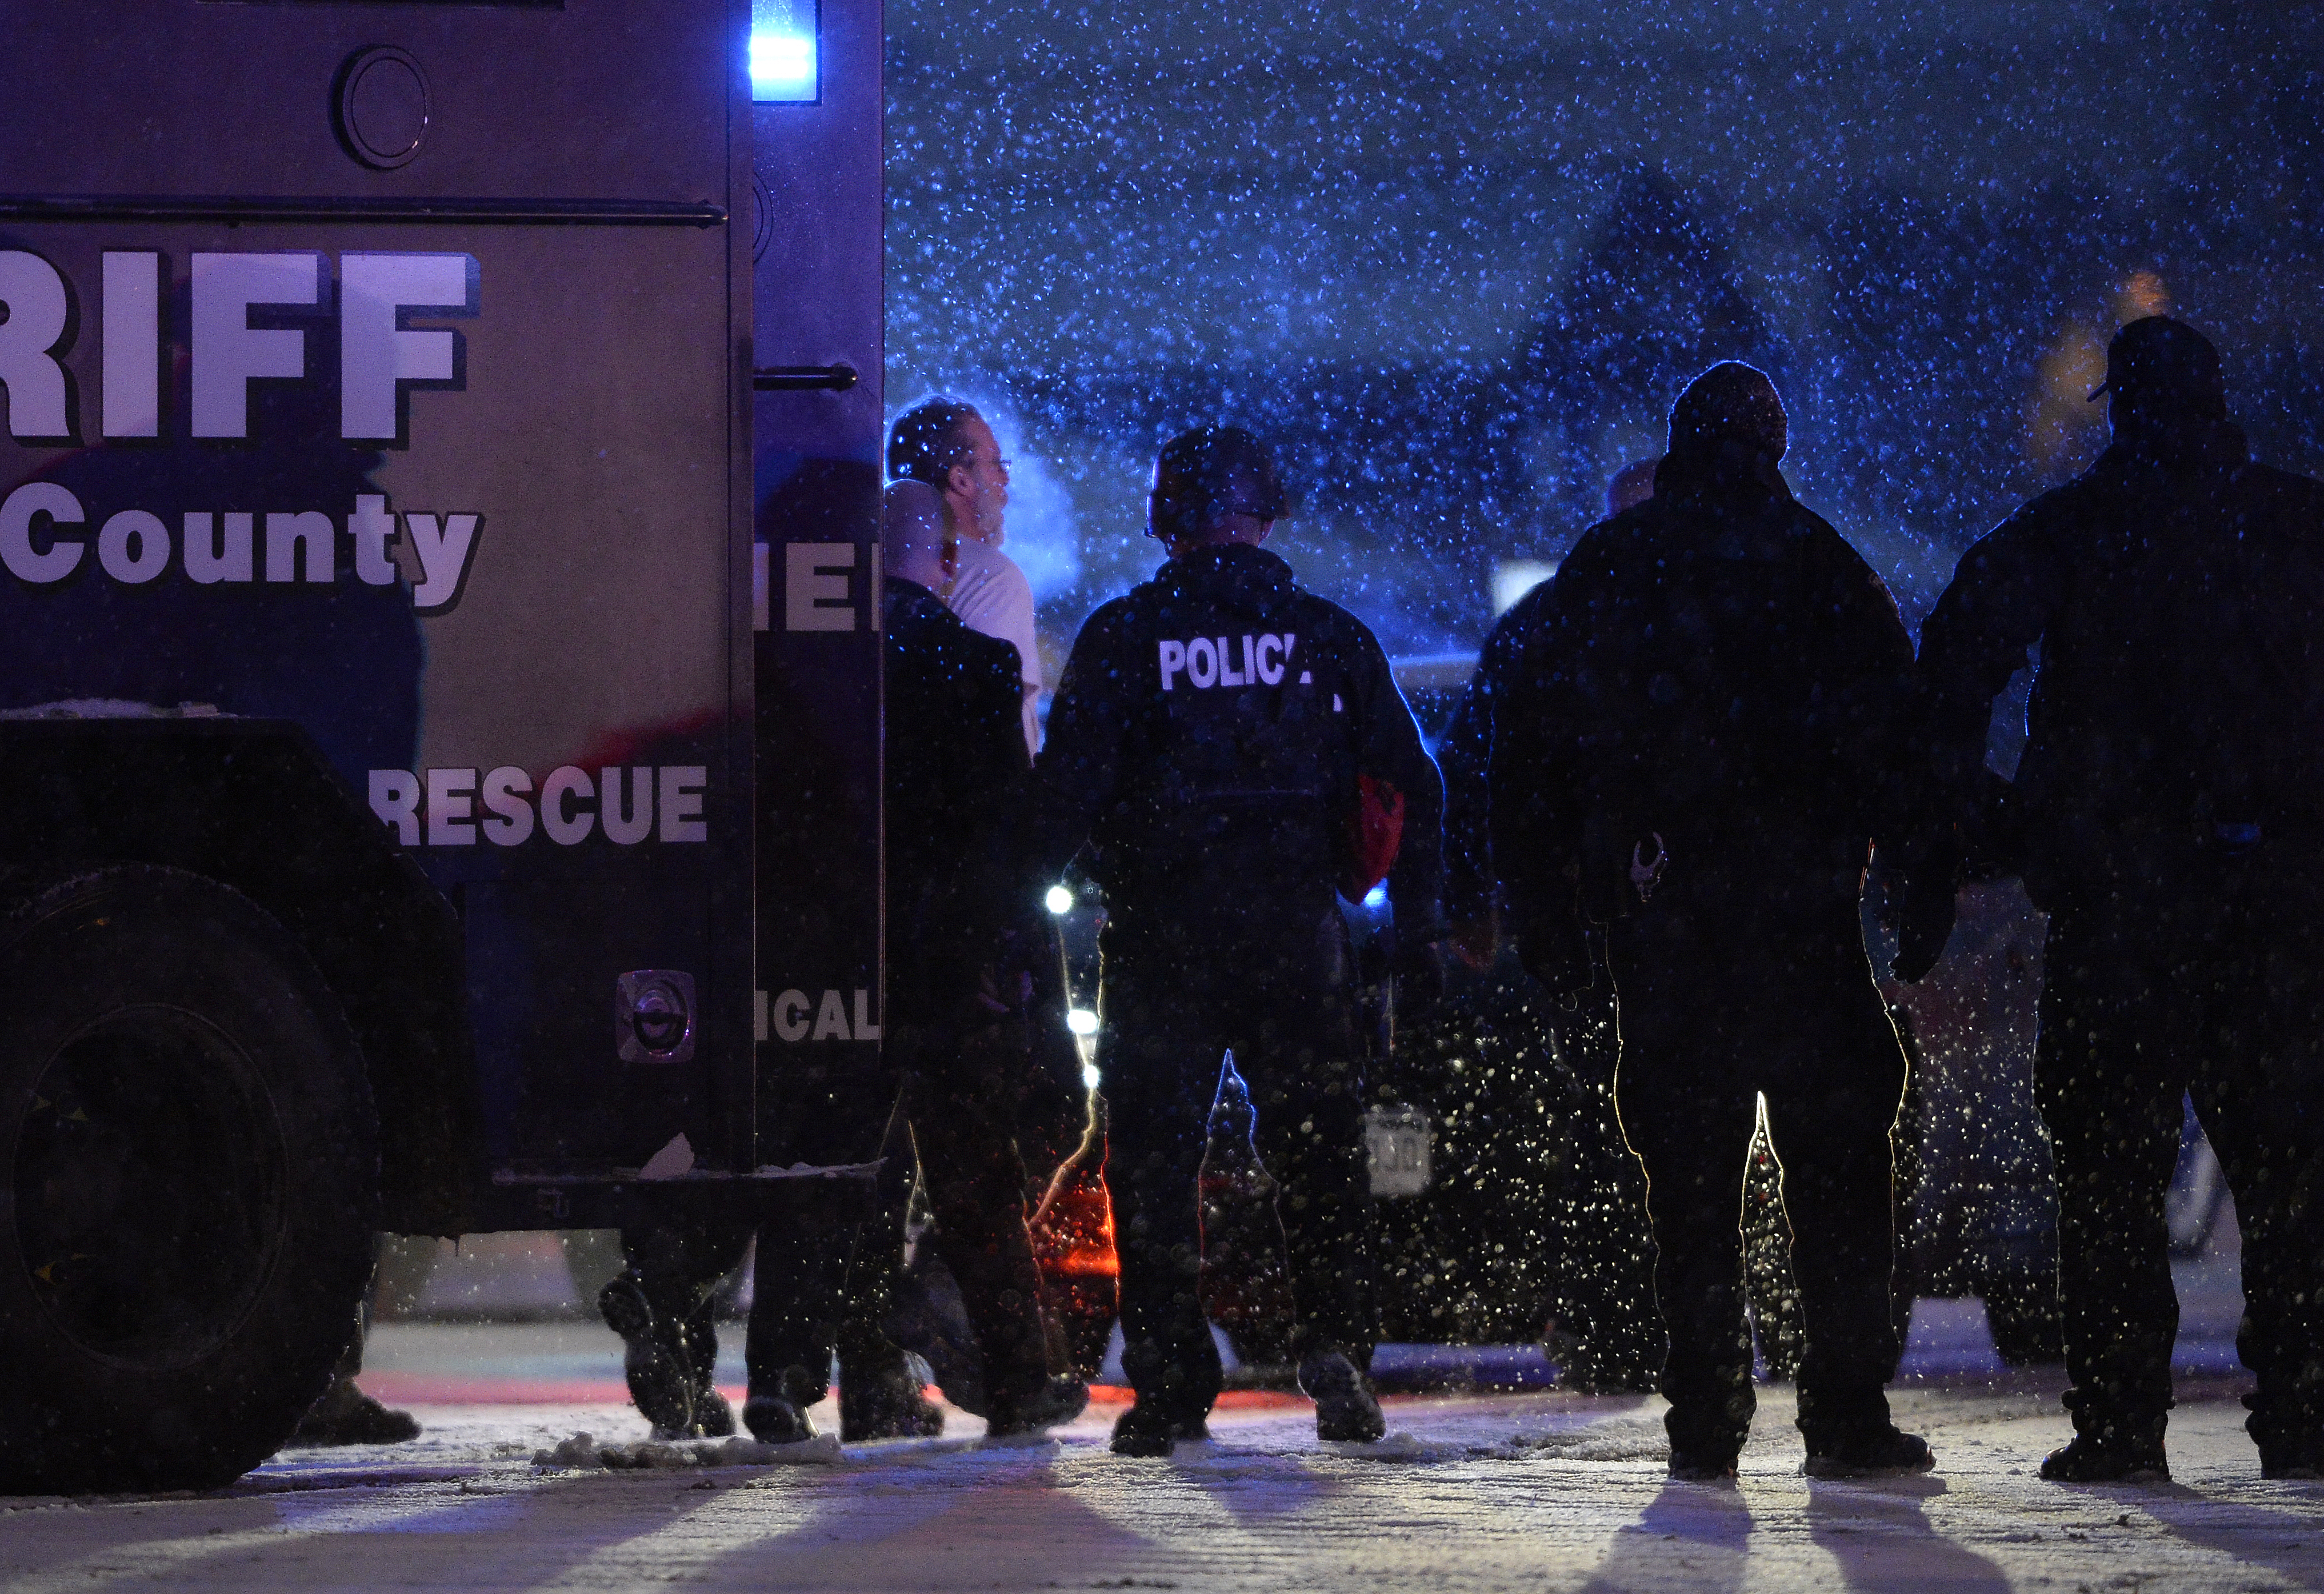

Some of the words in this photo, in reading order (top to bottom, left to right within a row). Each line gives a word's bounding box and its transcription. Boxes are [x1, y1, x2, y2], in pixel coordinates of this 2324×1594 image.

[0, 482, 481, 608] County
[368, 766, 707, 847] RESCUE
[754, 989, 881, 1042] ICAL
